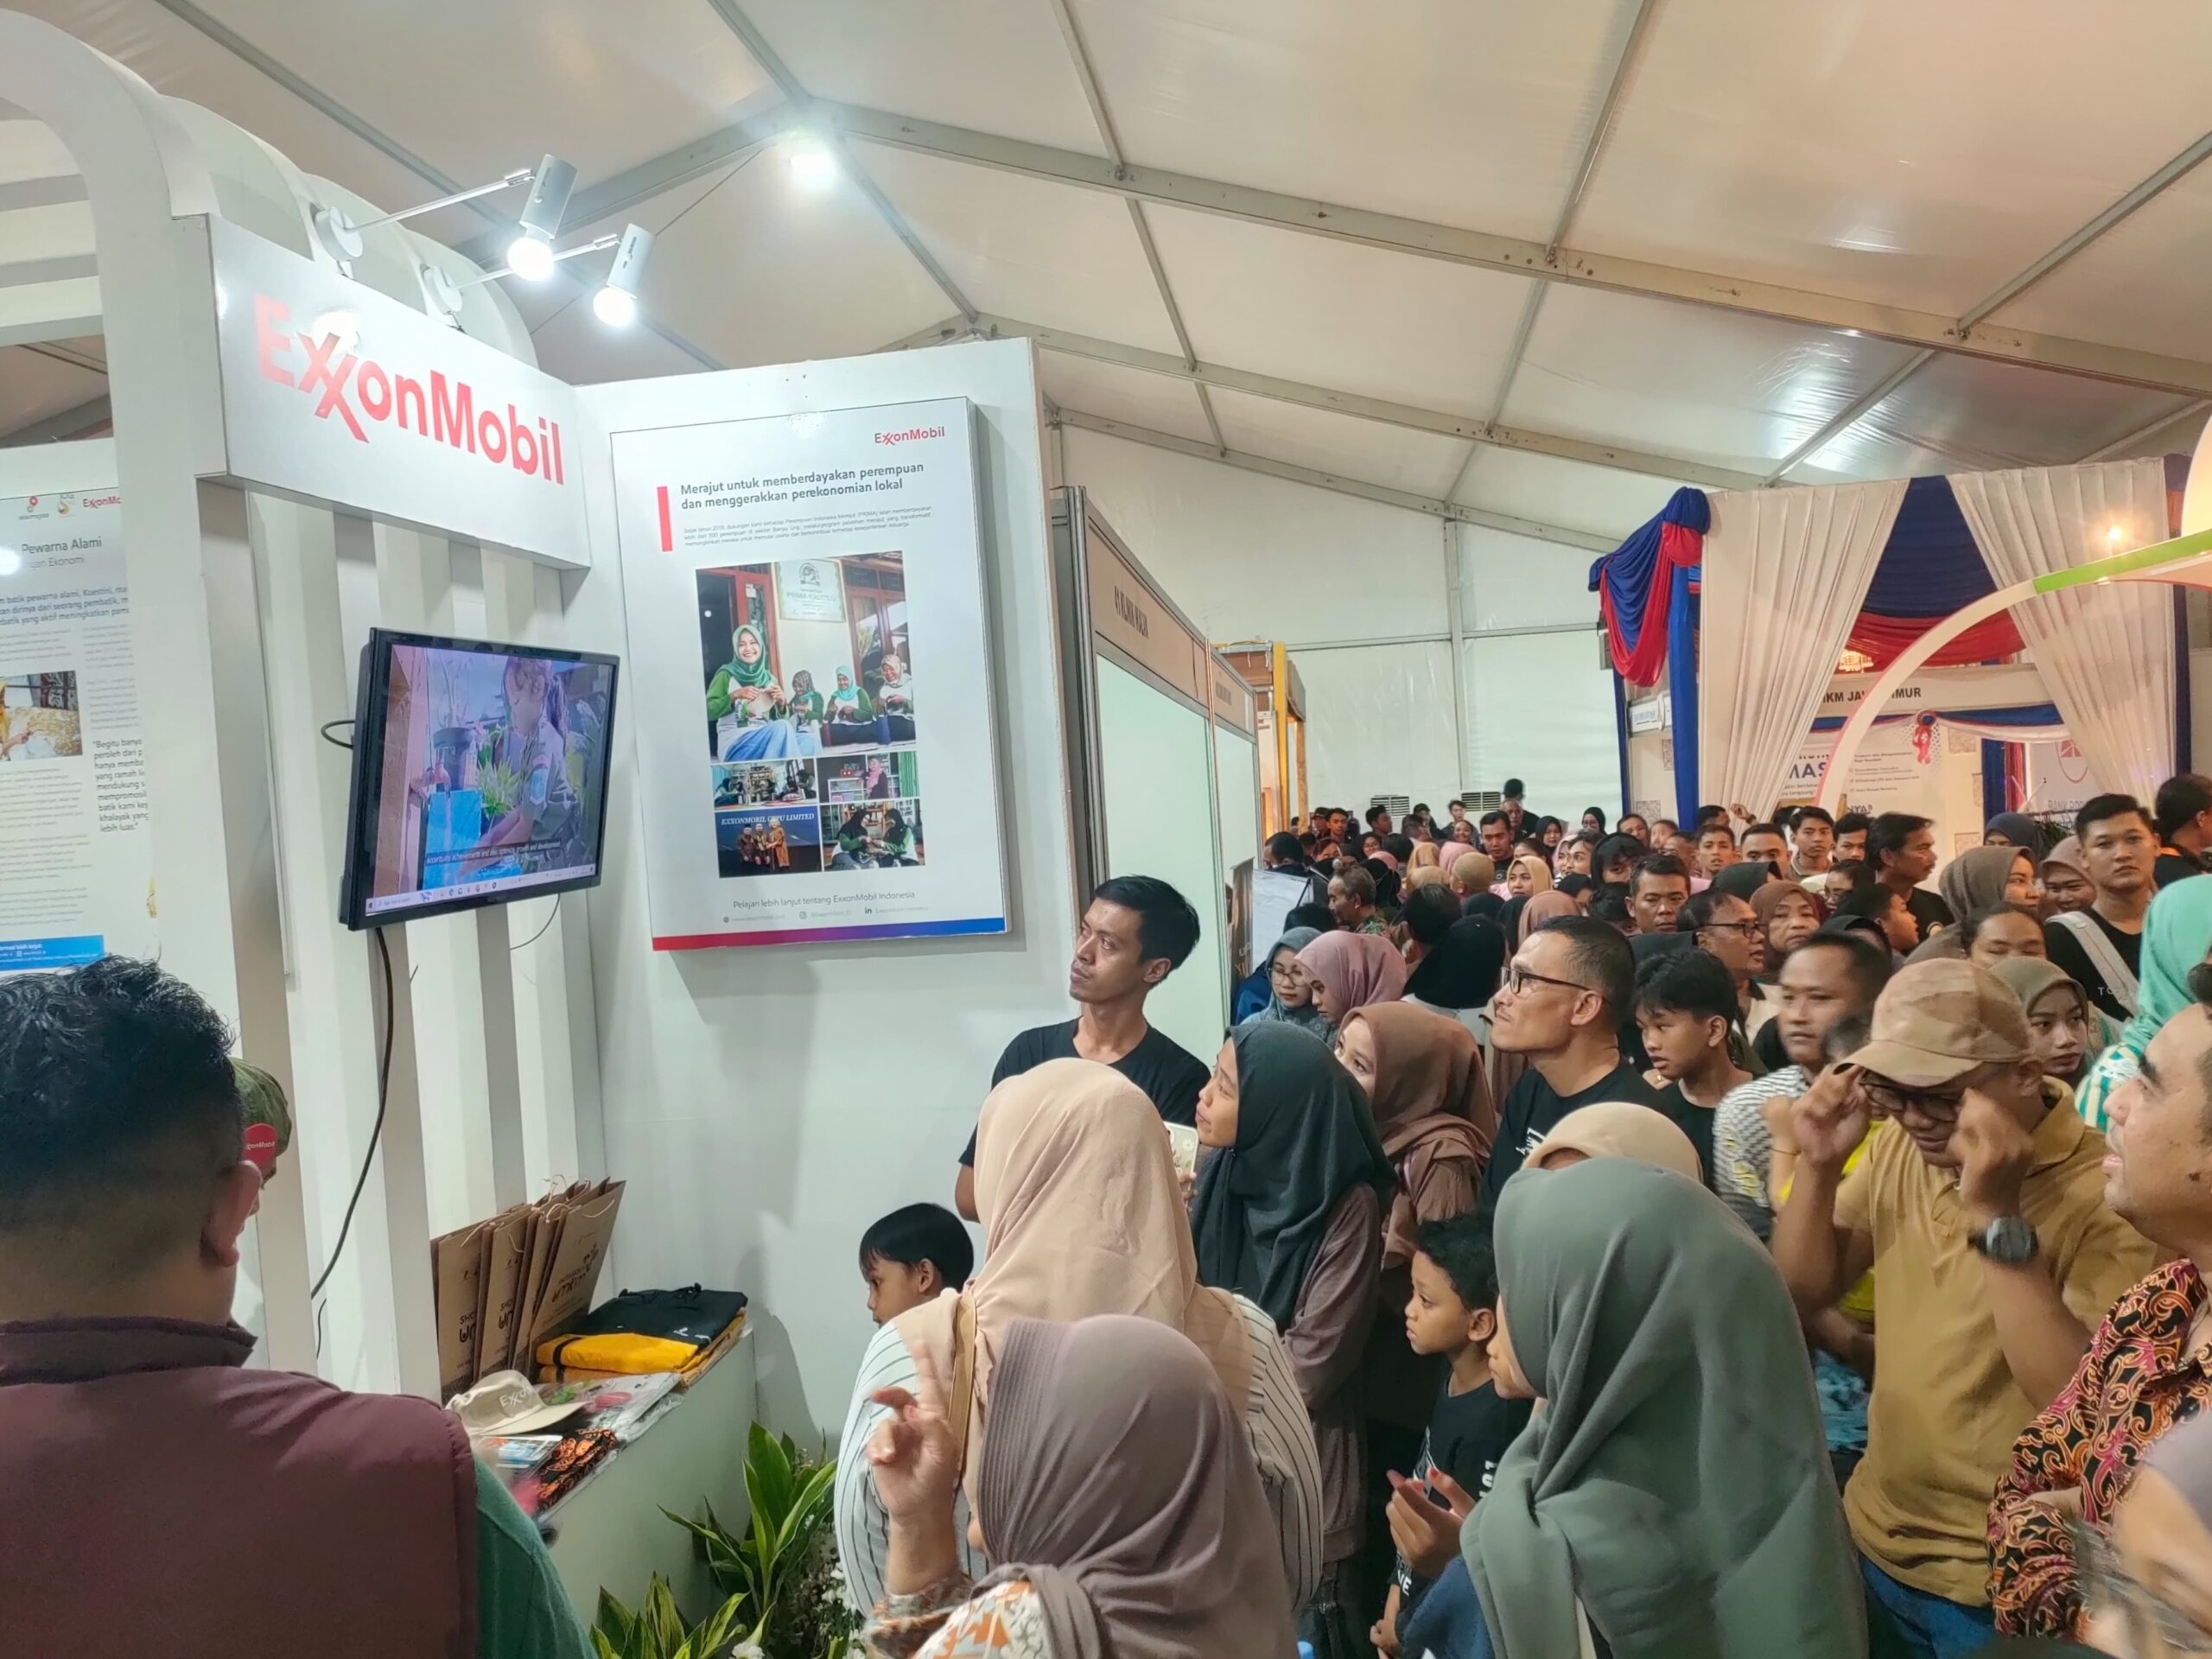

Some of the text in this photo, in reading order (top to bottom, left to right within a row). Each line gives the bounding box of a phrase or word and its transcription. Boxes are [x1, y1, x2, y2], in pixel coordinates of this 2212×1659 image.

[253, 292, 564, 486] ExxonMobil
[874, 426, 945, 445] ExxonMobil
[681, 463, 924, 495] Merajut untuk memberdayakan perempuan
[681, 479, 903, 510] dan menggerakkan perekonomian lokal
[22, 536, 102, 555] Pewarna Alami
[721, 816, 766, 825] EXXONMOBIL
[733, 891, 915, 910] Pelajari lebih lanjut tentang ExxonMobil Indonesia
